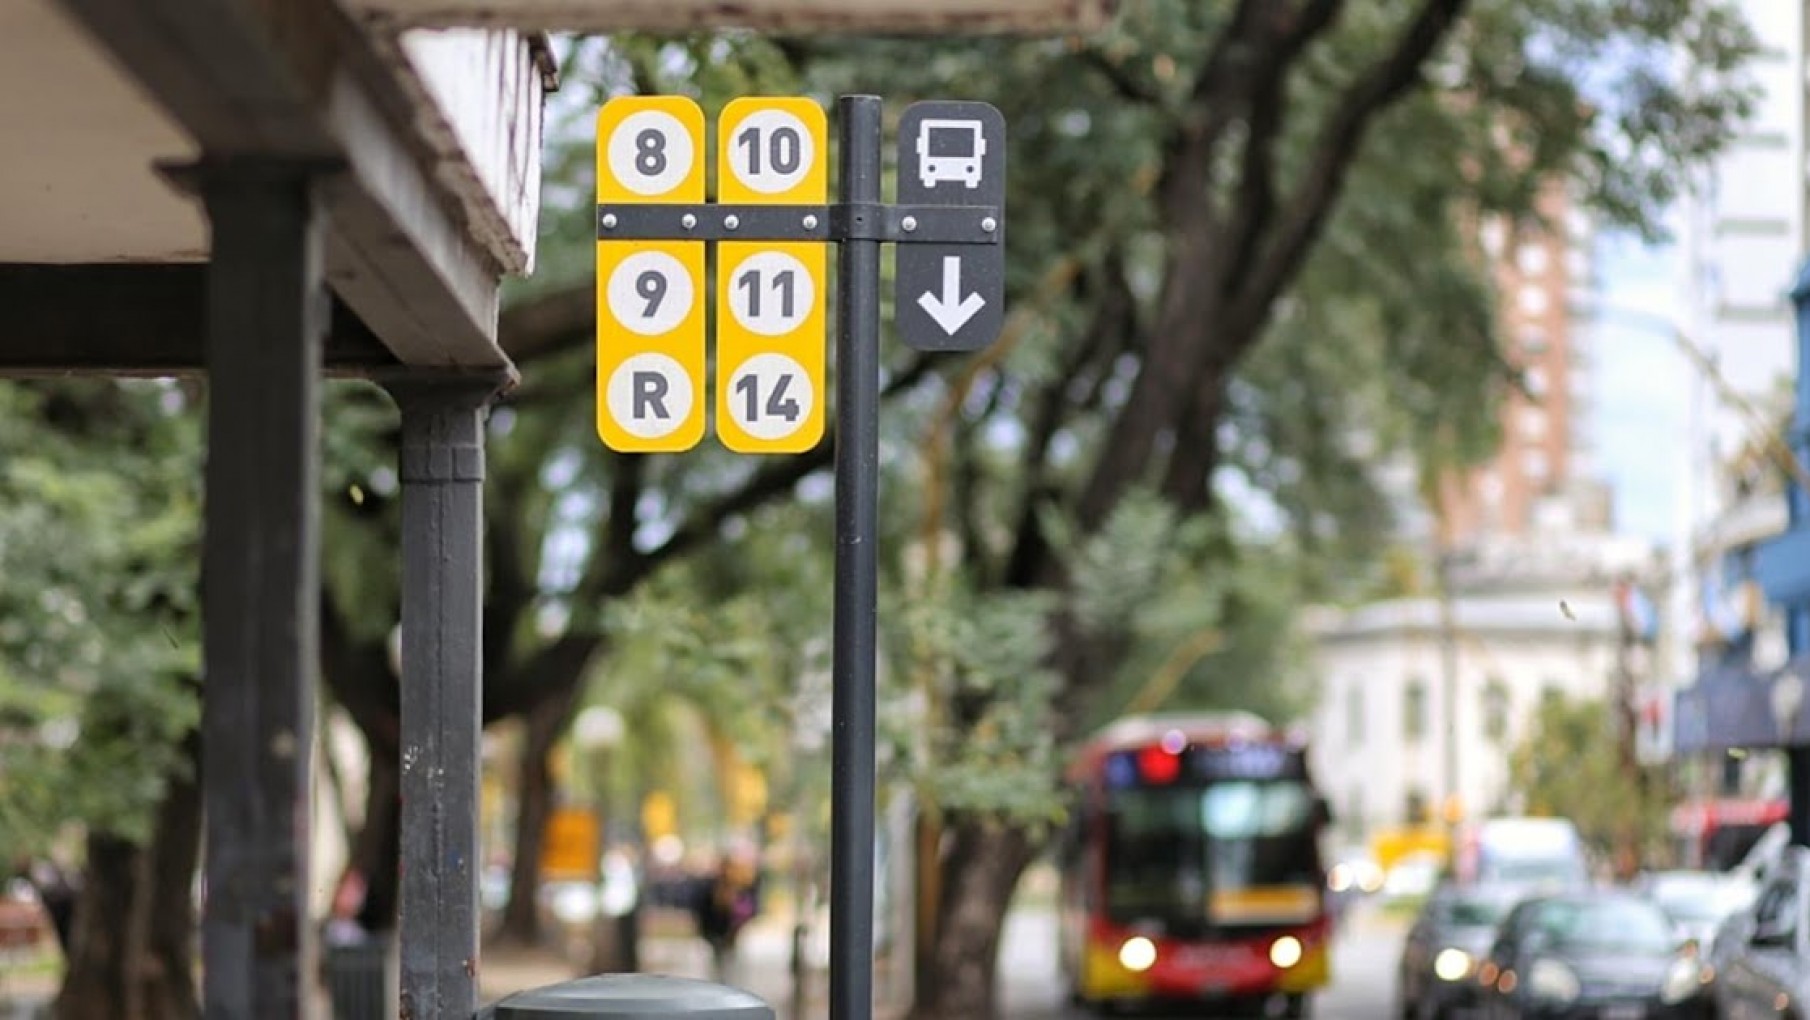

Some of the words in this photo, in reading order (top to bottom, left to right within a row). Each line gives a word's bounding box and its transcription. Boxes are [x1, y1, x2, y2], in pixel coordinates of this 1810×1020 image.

[636, 129, 666, 175] 8
[739, 127, 800, 174] 10
[636, 270, 666, 317] 9
[739, 270, 794, 317] 11
[634, 372, 669, 418] R
[737, 374, 799, 421] 14
